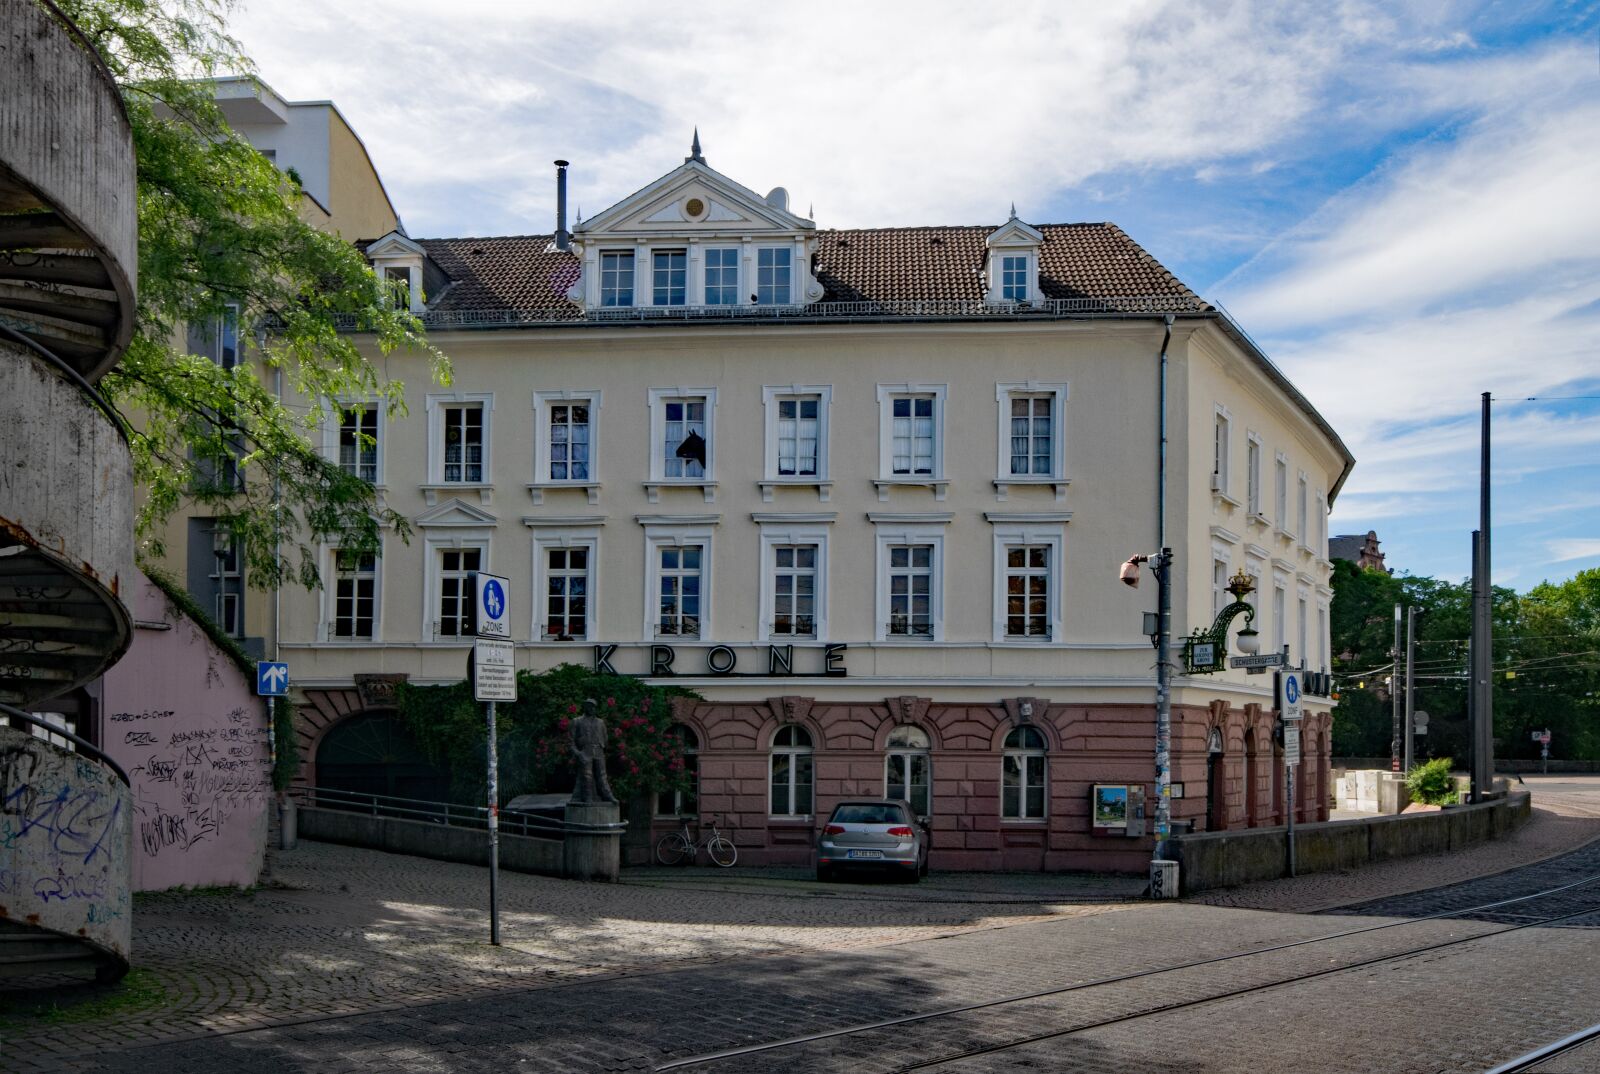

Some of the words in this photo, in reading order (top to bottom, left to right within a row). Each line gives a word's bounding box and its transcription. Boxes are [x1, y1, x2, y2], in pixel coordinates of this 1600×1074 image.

[485, 621, 503, 633] ZONE
[593, 643, 847, 674] KRONE
[1235, 657, 1278, 666] SCHUSTERGAE
